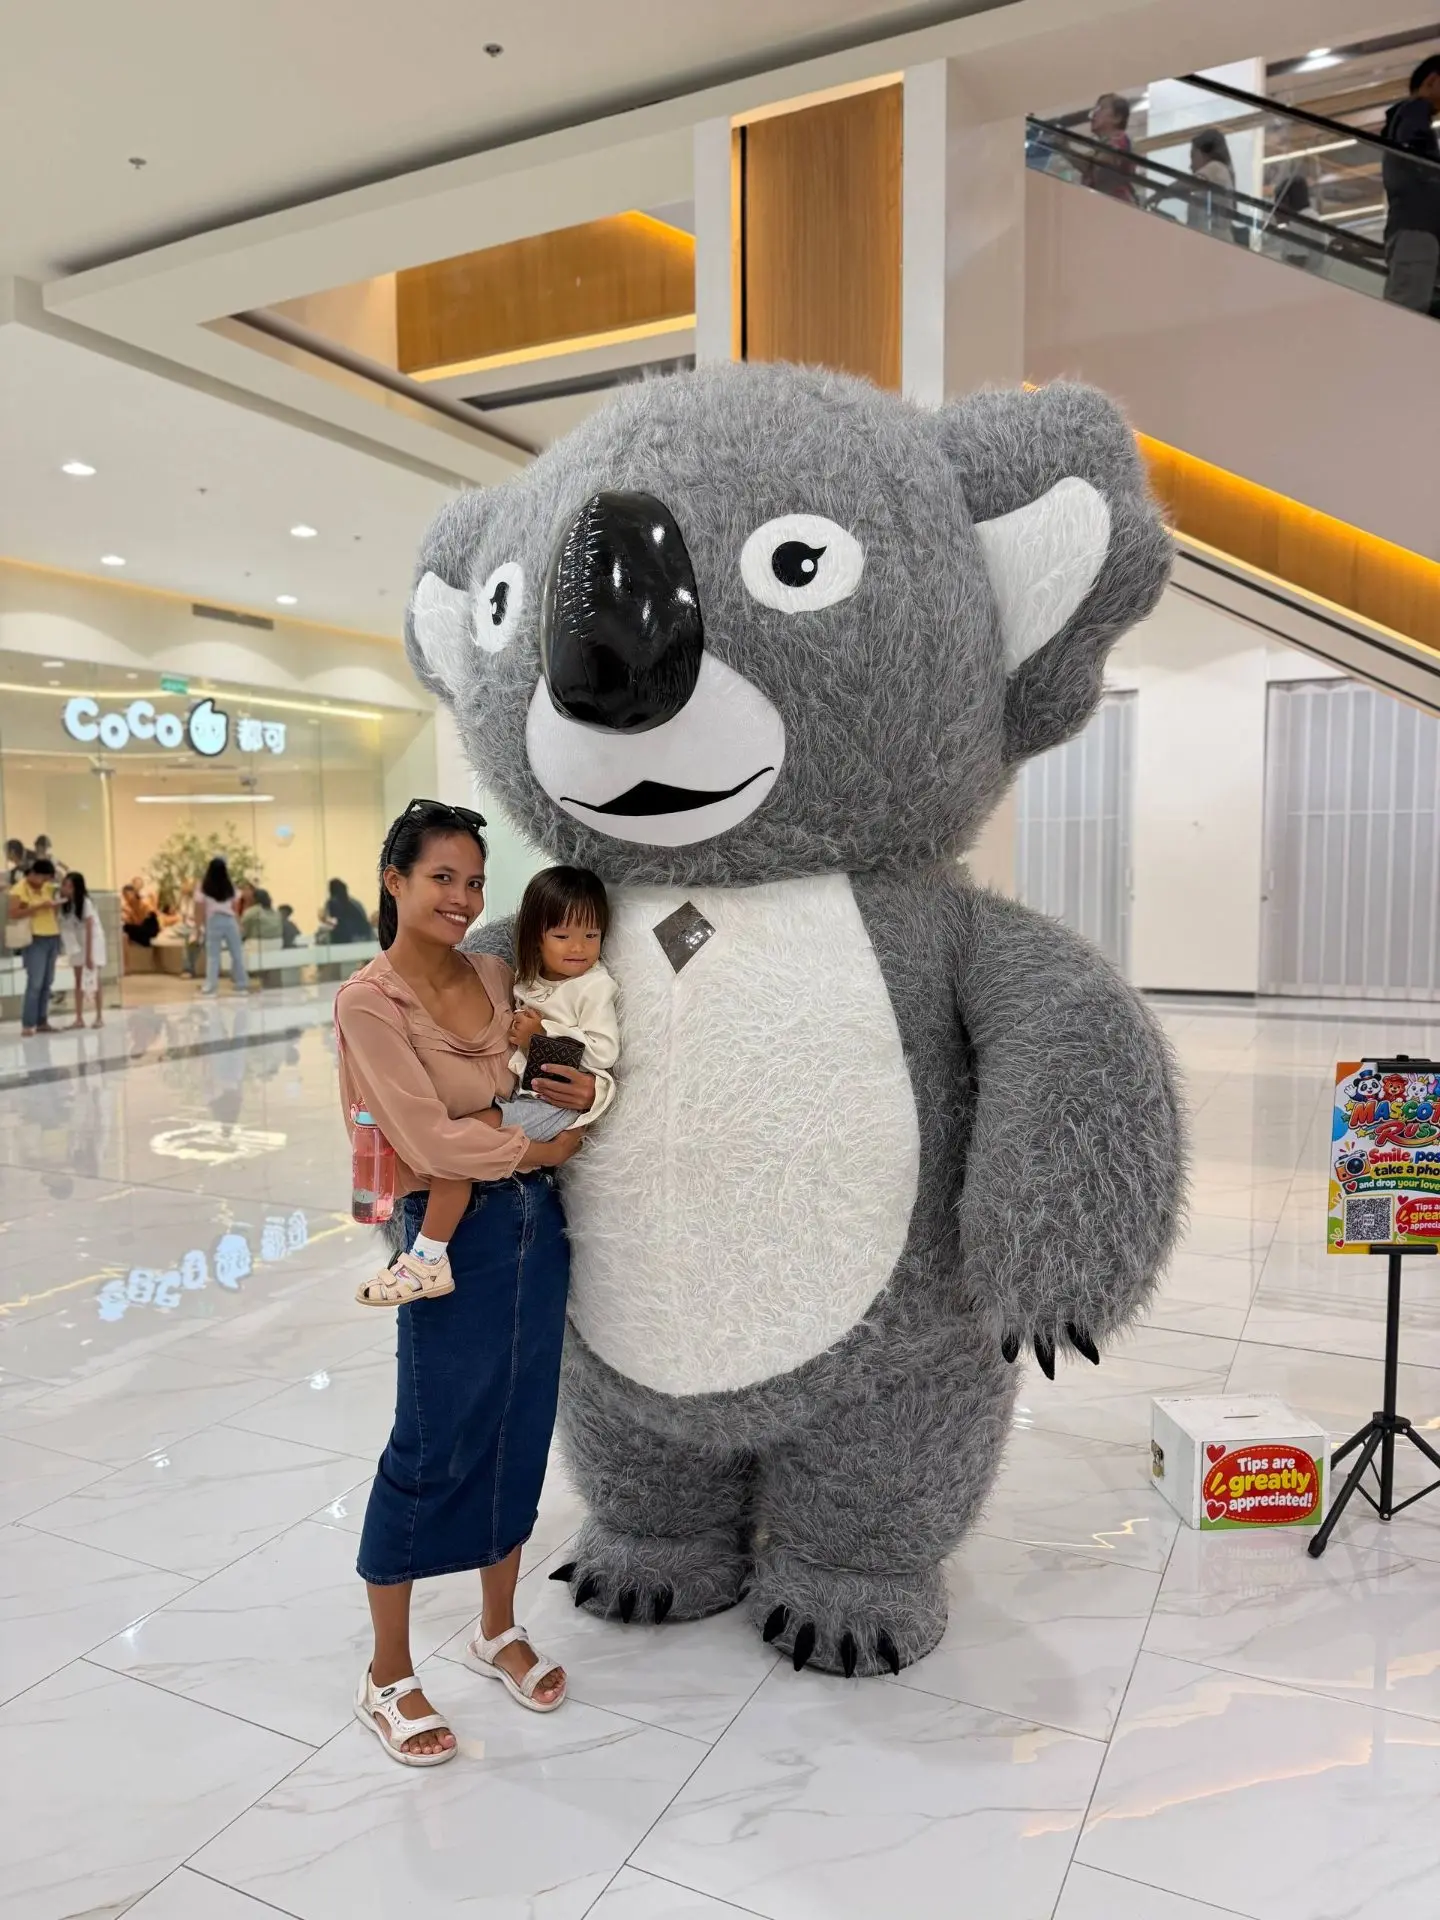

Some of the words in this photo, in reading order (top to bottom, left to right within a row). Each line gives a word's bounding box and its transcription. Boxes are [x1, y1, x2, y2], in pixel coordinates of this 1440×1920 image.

[63, 696, 184, 750] CoCo
[1368, 1148, 1413, 1164] Smile,
[1374, 1164, 1403, 1176] take
[1406, 1165, 1414, 1173] a
[1359, 1180, 1374, 1189] and
[1376, 1179, 1396, 1188] drop
[1398, 1180, 1419, 1188] your
[1415, 1203, 1432, 1212] Tips
[1237, 1457, 1269, 1473] Tips
[1272, 1457, 1296, 1469] are
[1229, 1468, 1311, 1497] greatly
[1229, 1492, 1312, 1512] appreciated!
